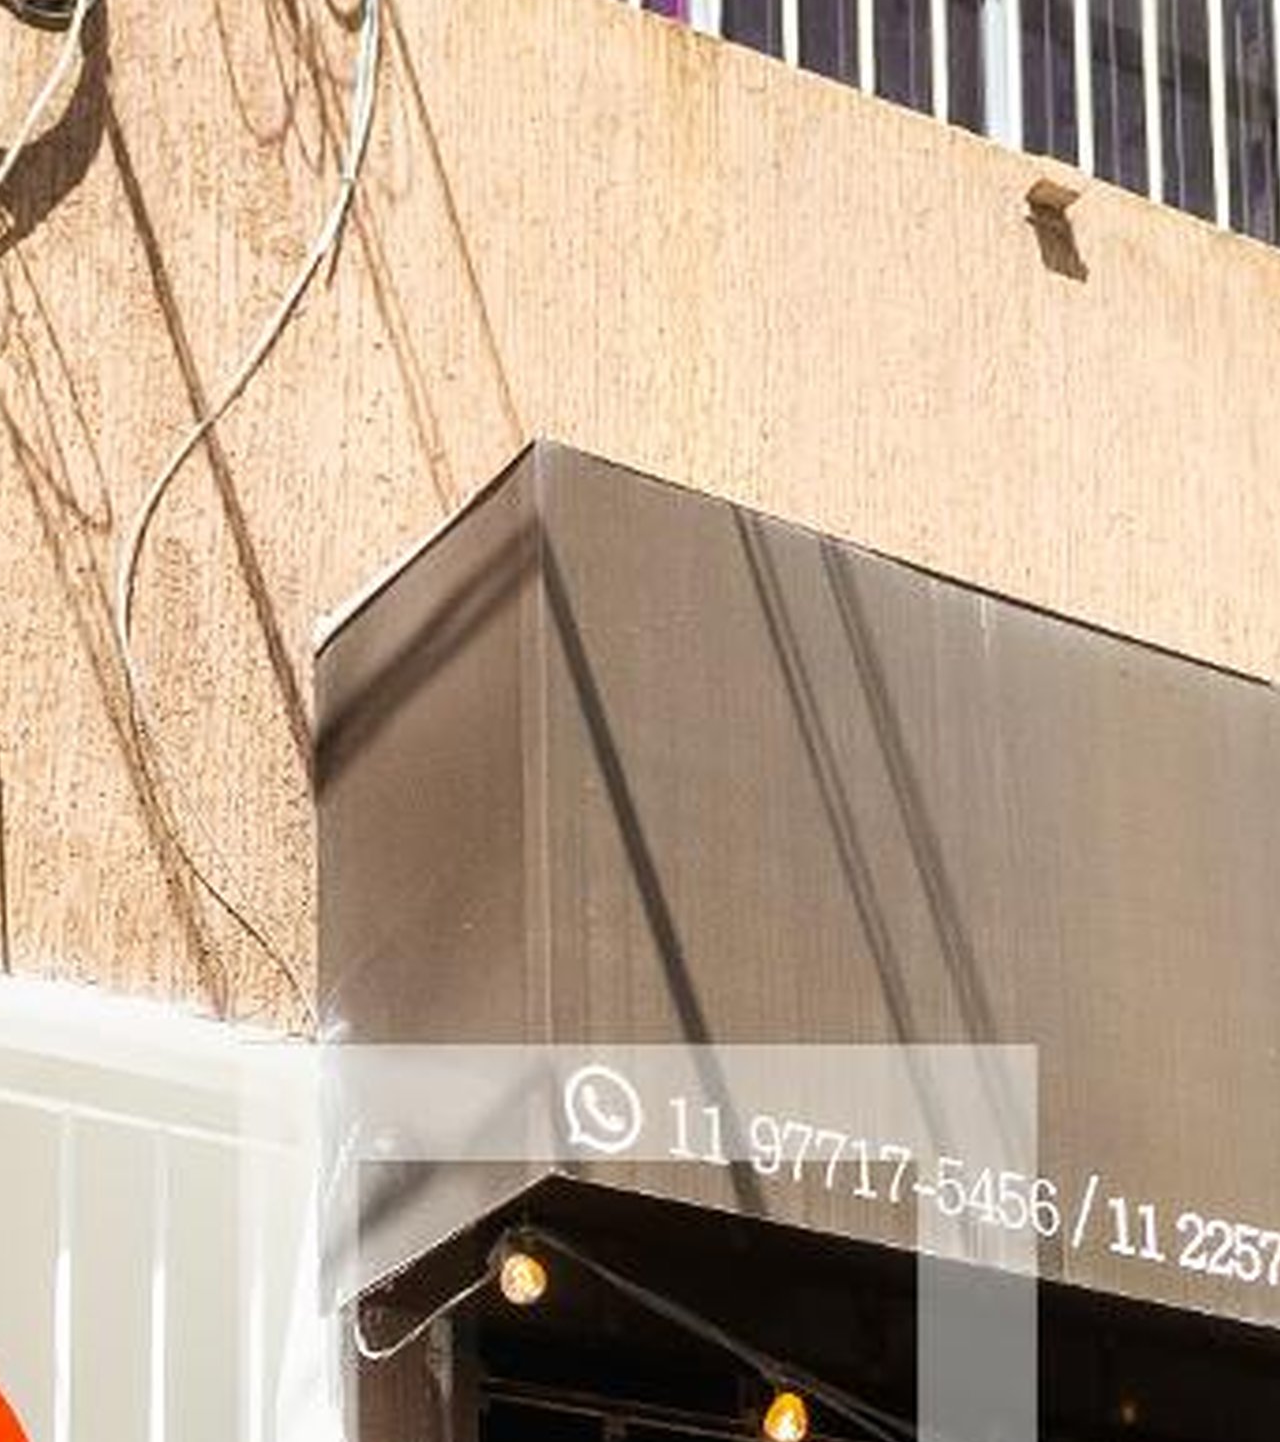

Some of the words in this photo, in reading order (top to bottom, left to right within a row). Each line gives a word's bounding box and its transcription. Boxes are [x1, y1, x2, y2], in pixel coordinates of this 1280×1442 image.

[669, 1096, 729, 1165] 11
[749, 1114, 1060, 1237] 97717-5456
[1108, 1197, 1165, 1262] 11
